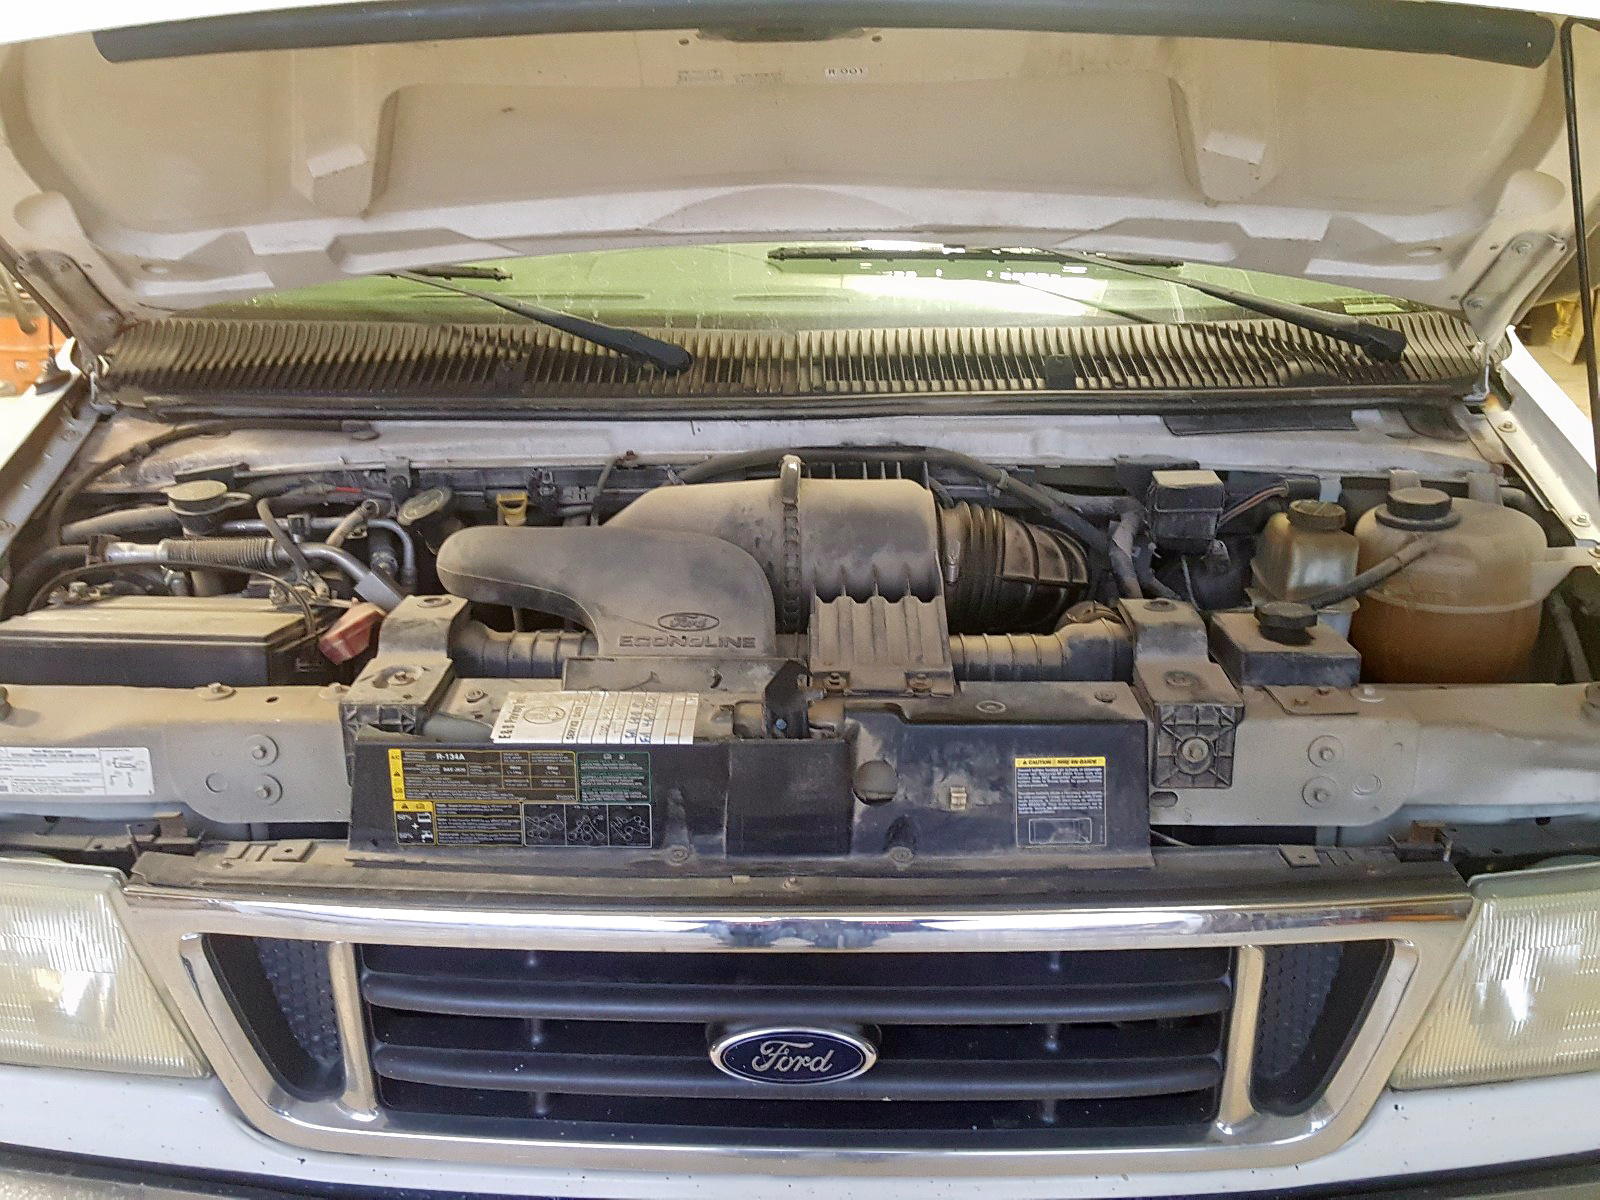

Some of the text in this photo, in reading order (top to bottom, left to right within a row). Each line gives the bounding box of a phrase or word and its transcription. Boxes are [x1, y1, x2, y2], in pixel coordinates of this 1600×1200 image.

[669, 615, 708, 629] Ford
[618, 635, 757, 649] ECONOLINE
[436, 752, 466, 761] R-134A
[751, 1040, 835, 1073] Ford
